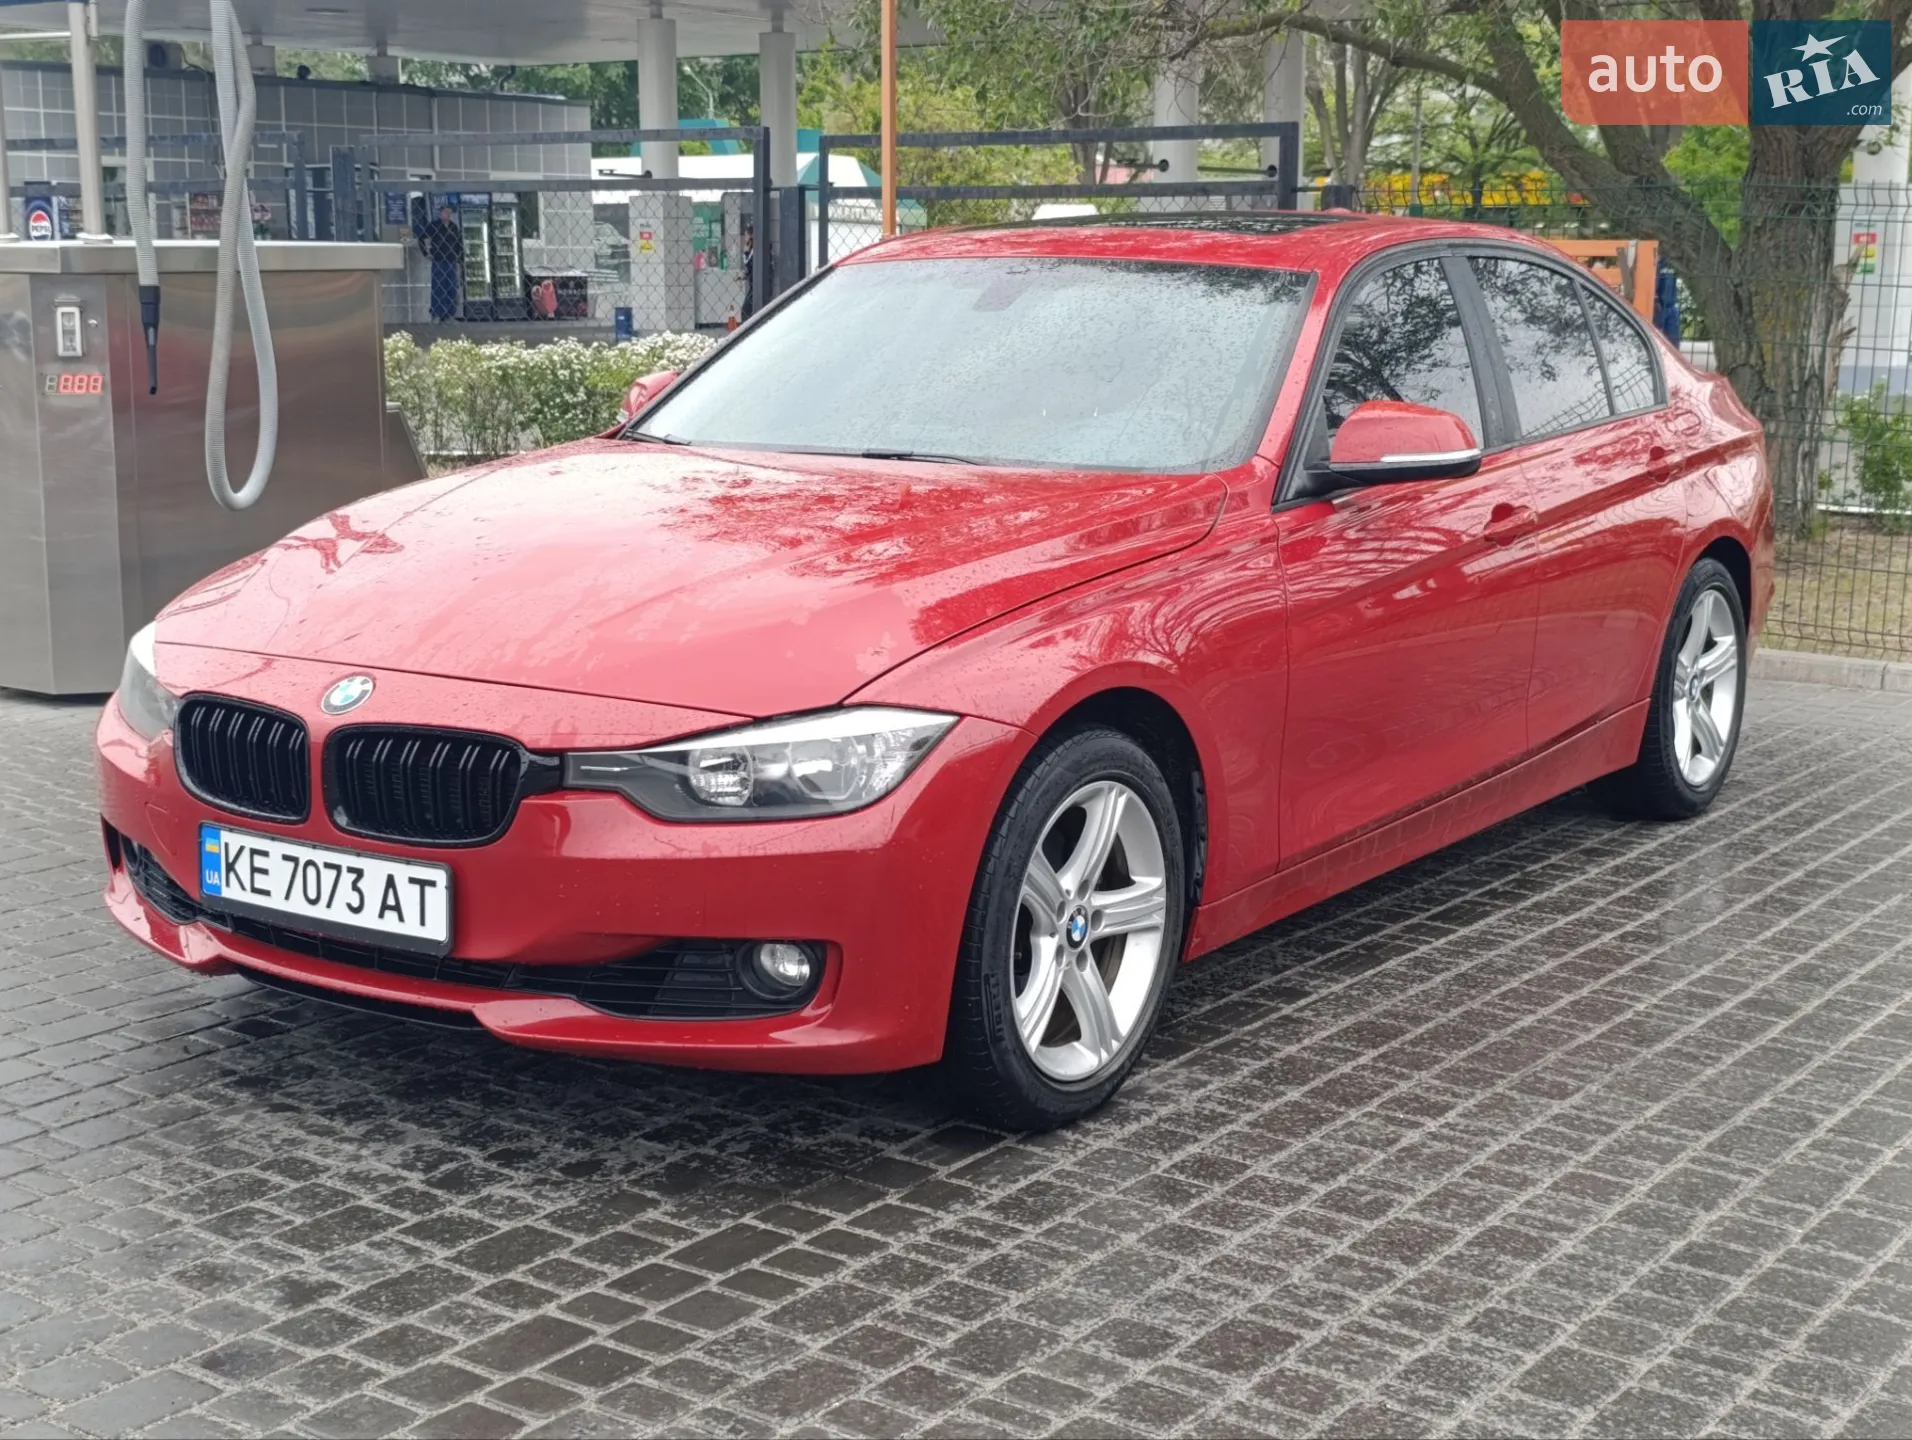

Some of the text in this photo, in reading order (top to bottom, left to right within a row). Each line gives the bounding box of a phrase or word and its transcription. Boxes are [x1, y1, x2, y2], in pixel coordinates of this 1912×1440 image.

[206, 869, 220, 885] UA
[224, 842, 437, 927] KE 7073 AT
